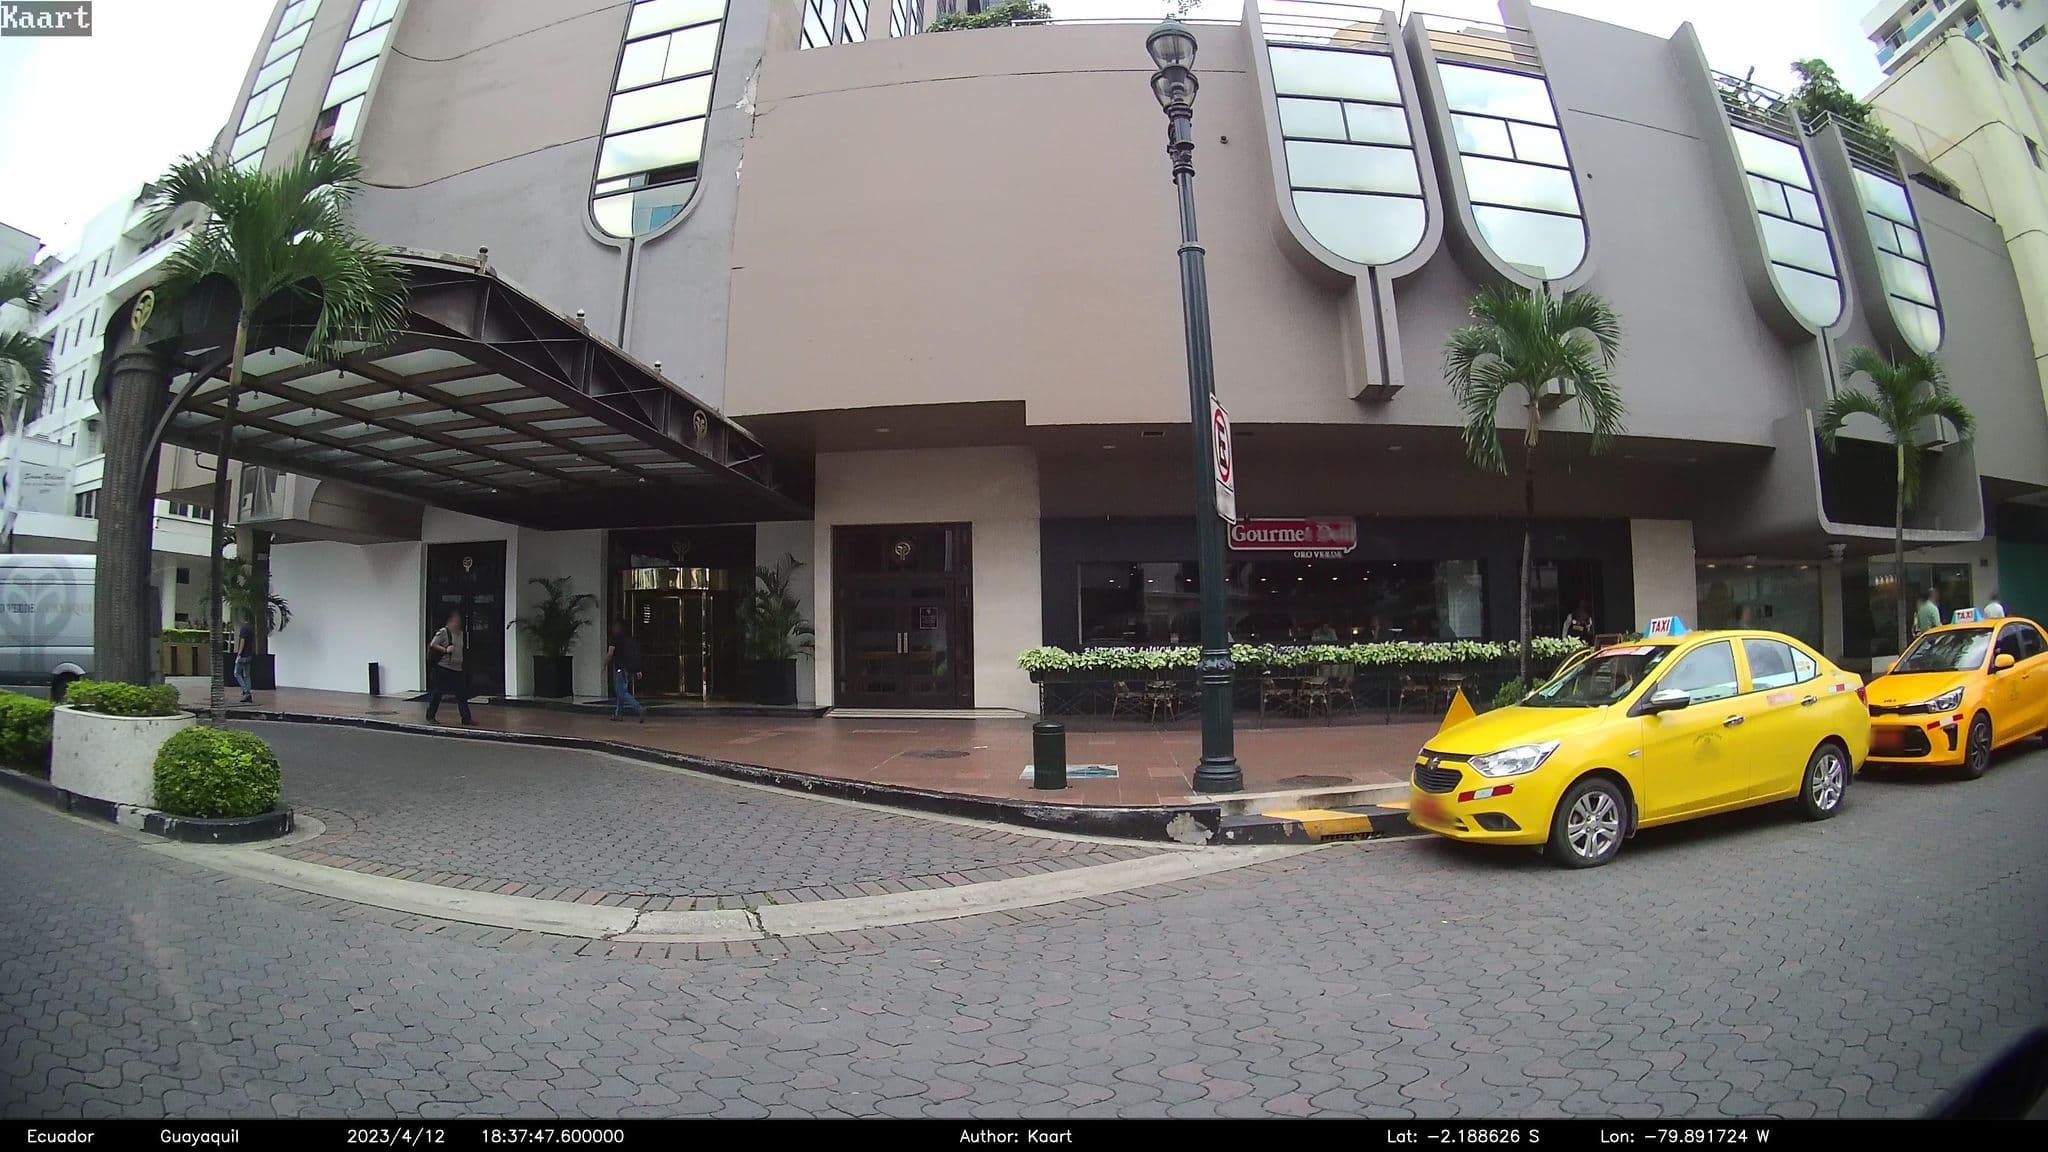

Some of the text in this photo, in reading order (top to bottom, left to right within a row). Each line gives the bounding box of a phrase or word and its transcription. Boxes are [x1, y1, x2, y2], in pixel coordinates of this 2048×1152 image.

[1293, 551, 1313, 559] ORO
[1957, 611, 1974, 619] TAXI
[1651, 619, 1670, 633] TAXI
